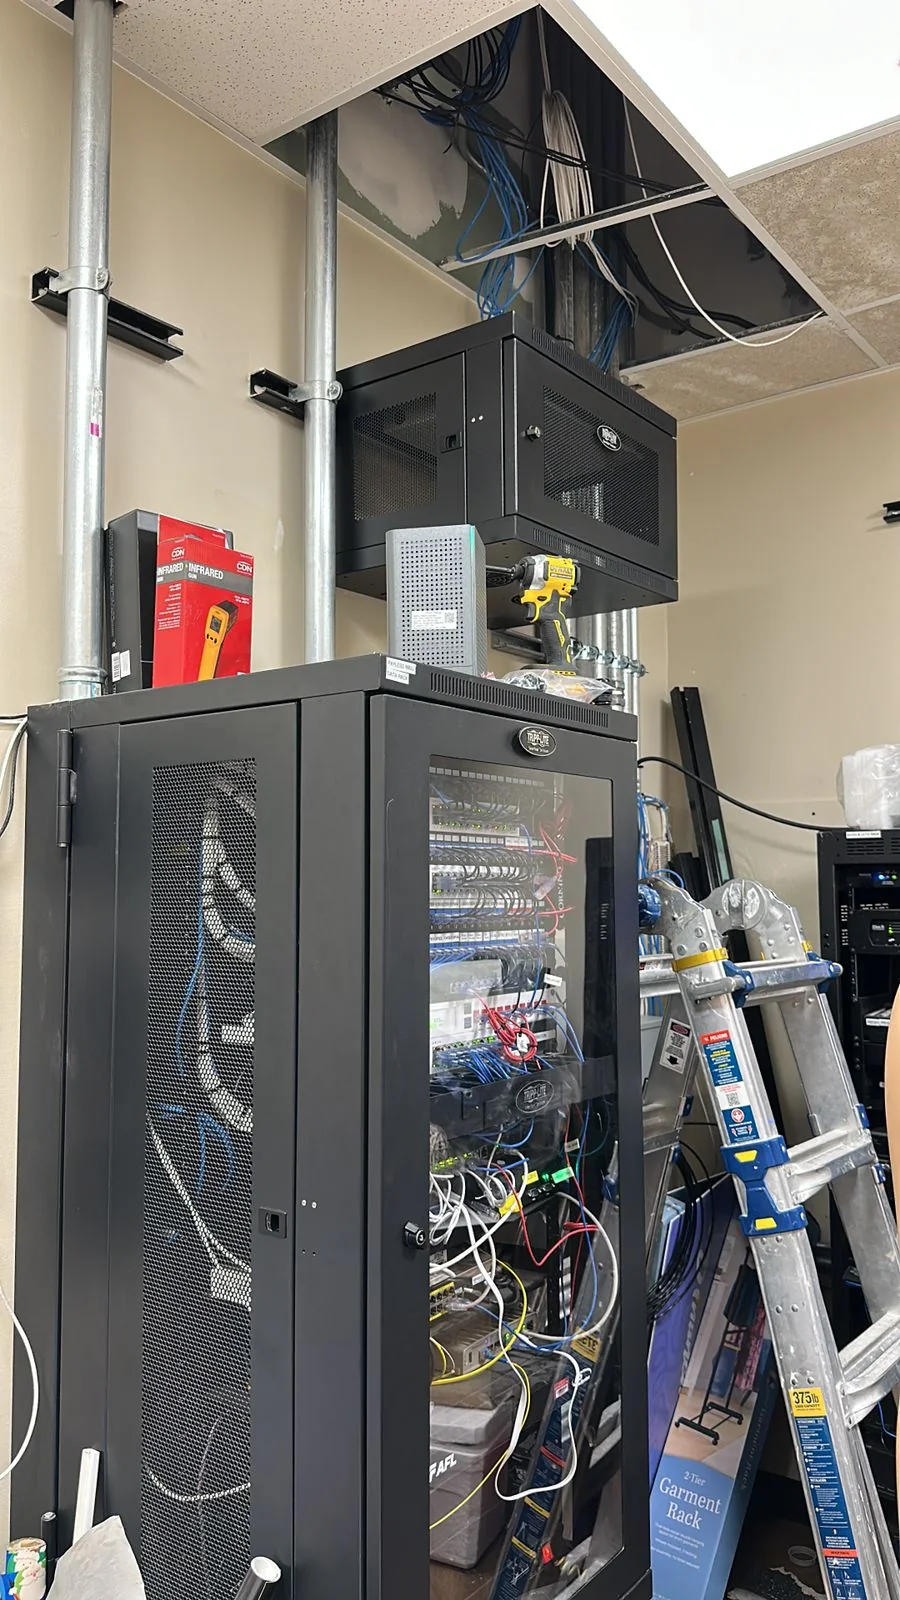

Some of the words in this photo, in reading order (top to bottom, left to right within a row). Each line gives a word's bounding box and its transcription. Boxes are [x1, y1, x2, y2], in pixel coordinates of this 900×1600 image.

[171, 547, 185, 558] CDN
[157, 562, 184, 576] INFRARED
[188, 563, 224, 580] INFRARED
[236, 562, 253, 573] CDN
[683, 1471, 706, 1486] 2-Tier
[659, 1476, 721, 1515] Garment
[666, 1501, 703, 1530] Rack
